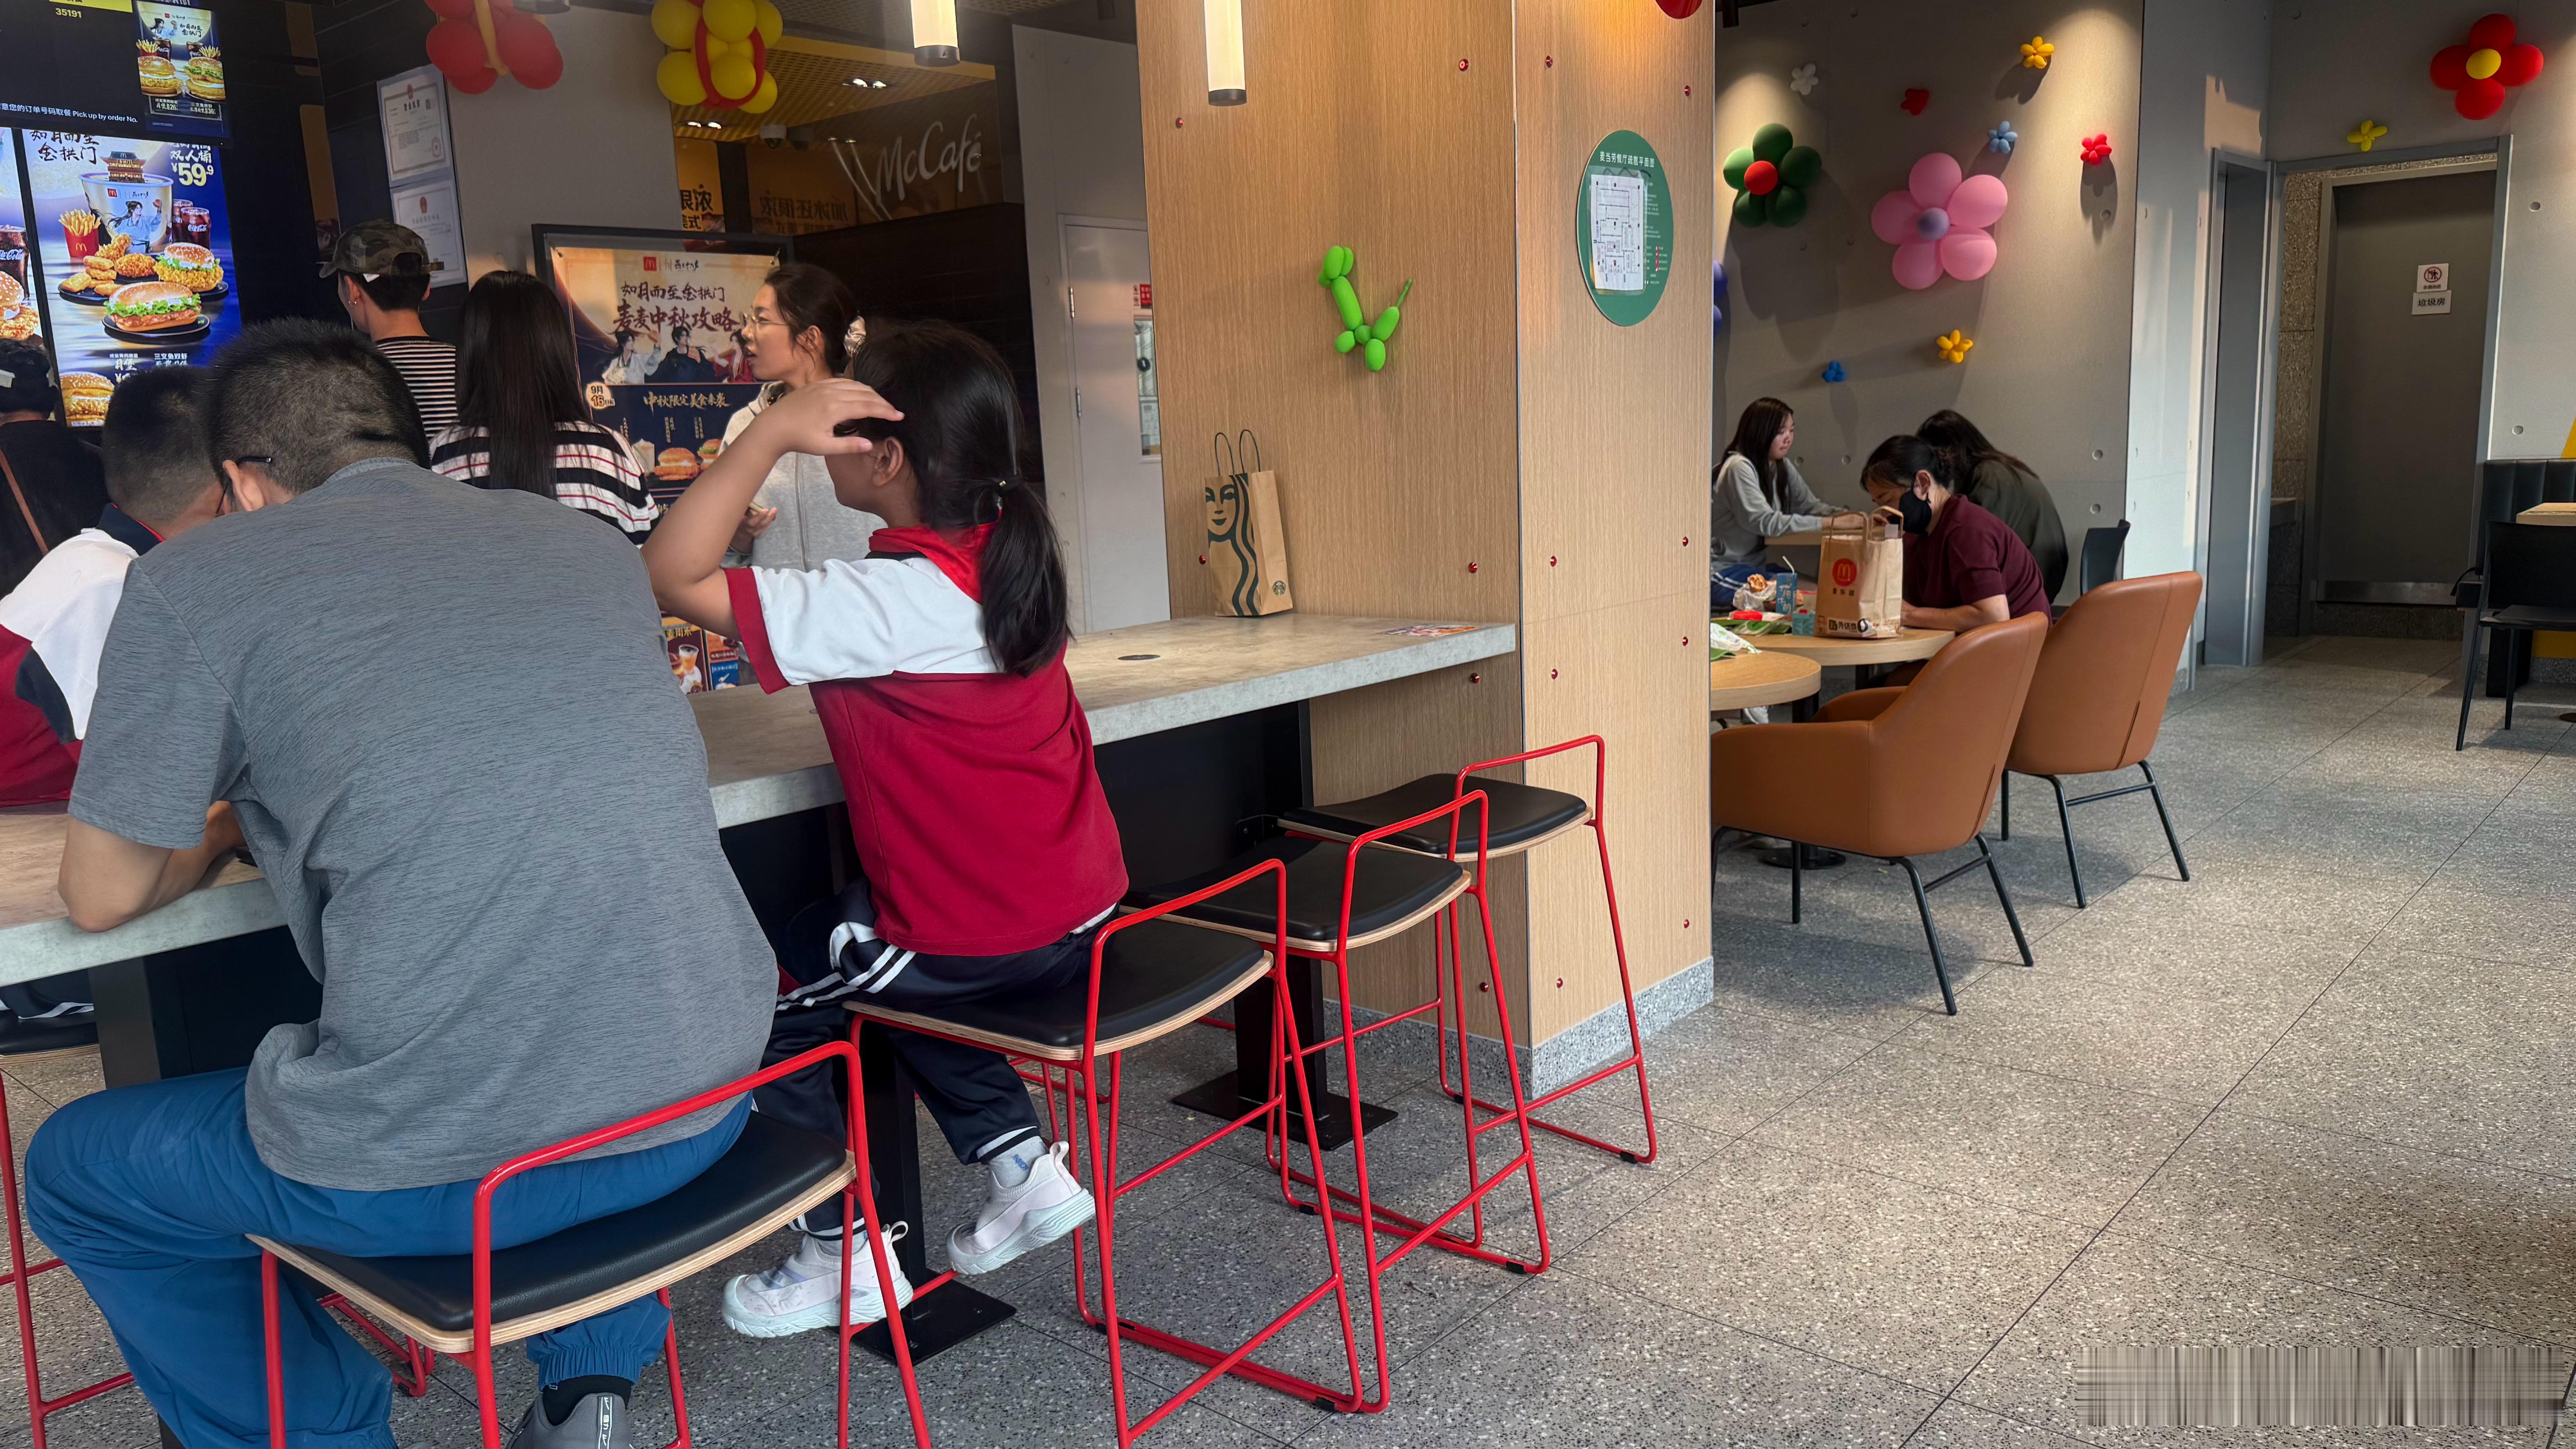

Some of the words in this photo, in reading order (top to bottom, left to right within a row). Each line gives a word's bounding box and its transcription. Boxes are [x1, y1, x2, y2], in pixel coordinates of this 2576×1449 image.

[55, 8, 82, 18] 35191
[0, 103, 71, 116] 意您的订单号码取餐
[38, 142, 98, 165] 金拱门
[170, 150, 212, 163] 双人桶
[875, 114, 982, 201] McCafé
[1600, 151, 1655, 168] 麦当劳餐厅疏散平面图
[621, 280, 725, 302] 如月而至金拱门
[2418, 298, 2445, 307] 垃圾房
[613, 298, 740, 334] 麦麦中秋攻略
[591, 386, 603, 394] 9月
